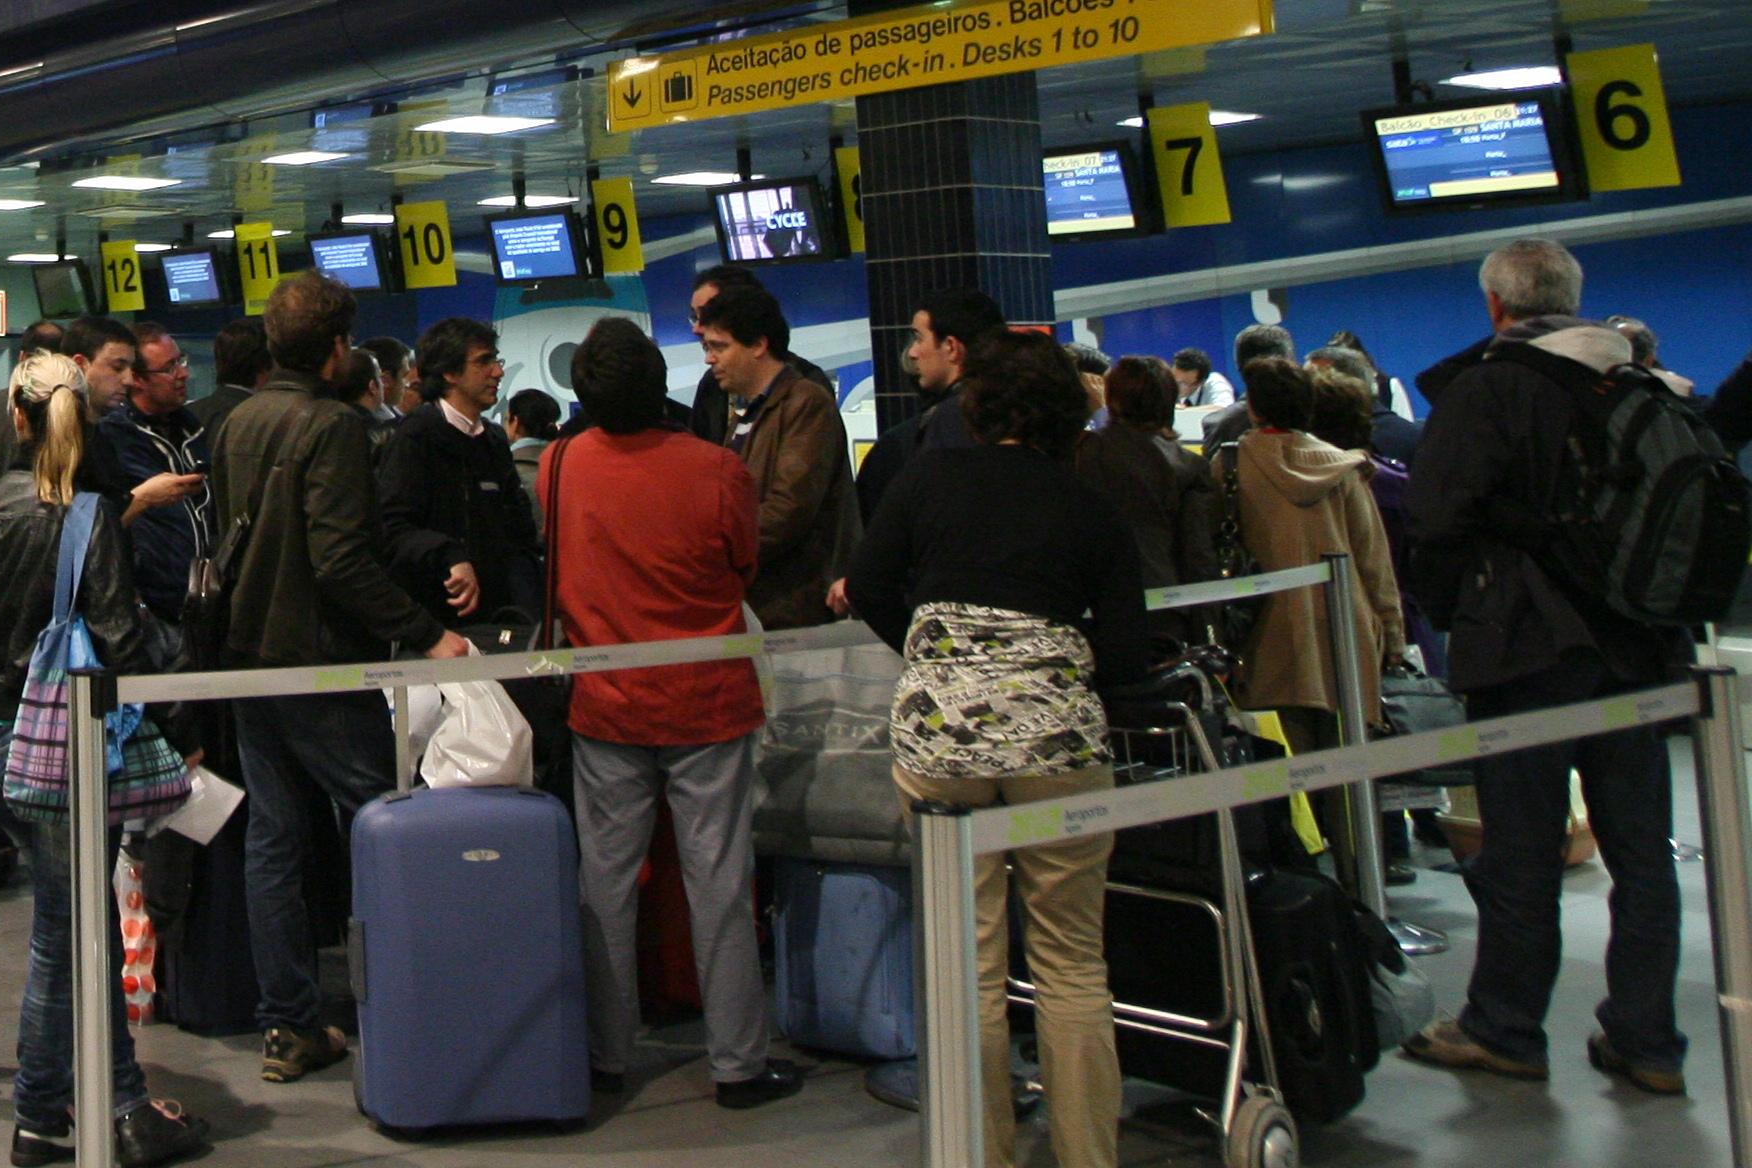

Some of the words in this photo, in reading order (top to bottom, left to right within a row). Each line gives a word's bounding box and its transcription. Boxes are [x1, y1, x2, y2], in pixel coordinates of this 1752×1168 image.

[706, 39, 807, 75] Aceitação
[814, 33, 841, 56] de
[707, 70, 831, 107] Passengers
[962, 35, 1042, 68] Desks
[1051, 28, 1063, 53] 1
[1073, 26, 1098, 50] to
[1109, 16, 1139, 44] 10
[1480, 120, 1511, 132] SANTA
[1512, 117, 1543, 128] MARIA
[1594, 78, 1649, 151] 6
[1164, 137, 1205, 195] 7
[604, 203, 629, 251] 9
[766, 211, 807, 229] CYCLE
[243, 241, 271, 280] 11
[402, 223, 446, 266] 10
[106, 257, 137, 294] 12
